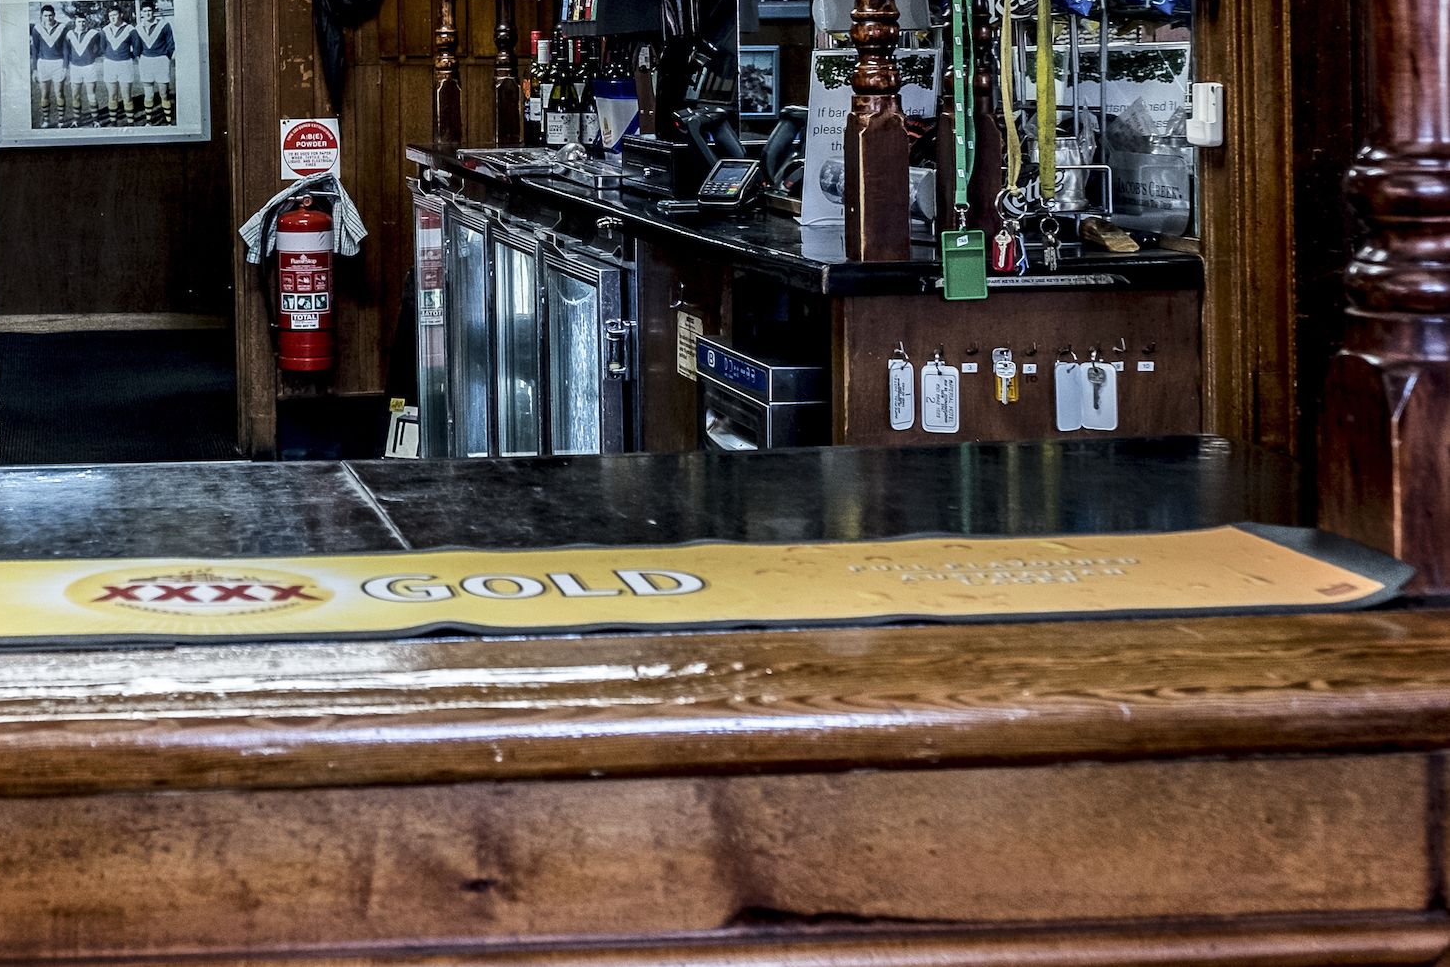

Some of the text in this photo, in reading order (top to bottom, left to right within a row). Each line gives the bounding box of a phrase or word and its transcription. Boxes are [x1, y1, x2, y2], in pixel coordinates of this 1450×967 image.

[818, 107, 846, 118] If bar
[91, 584, 321, 603] XXXX
[360, 569, 707, 605] GOLD
